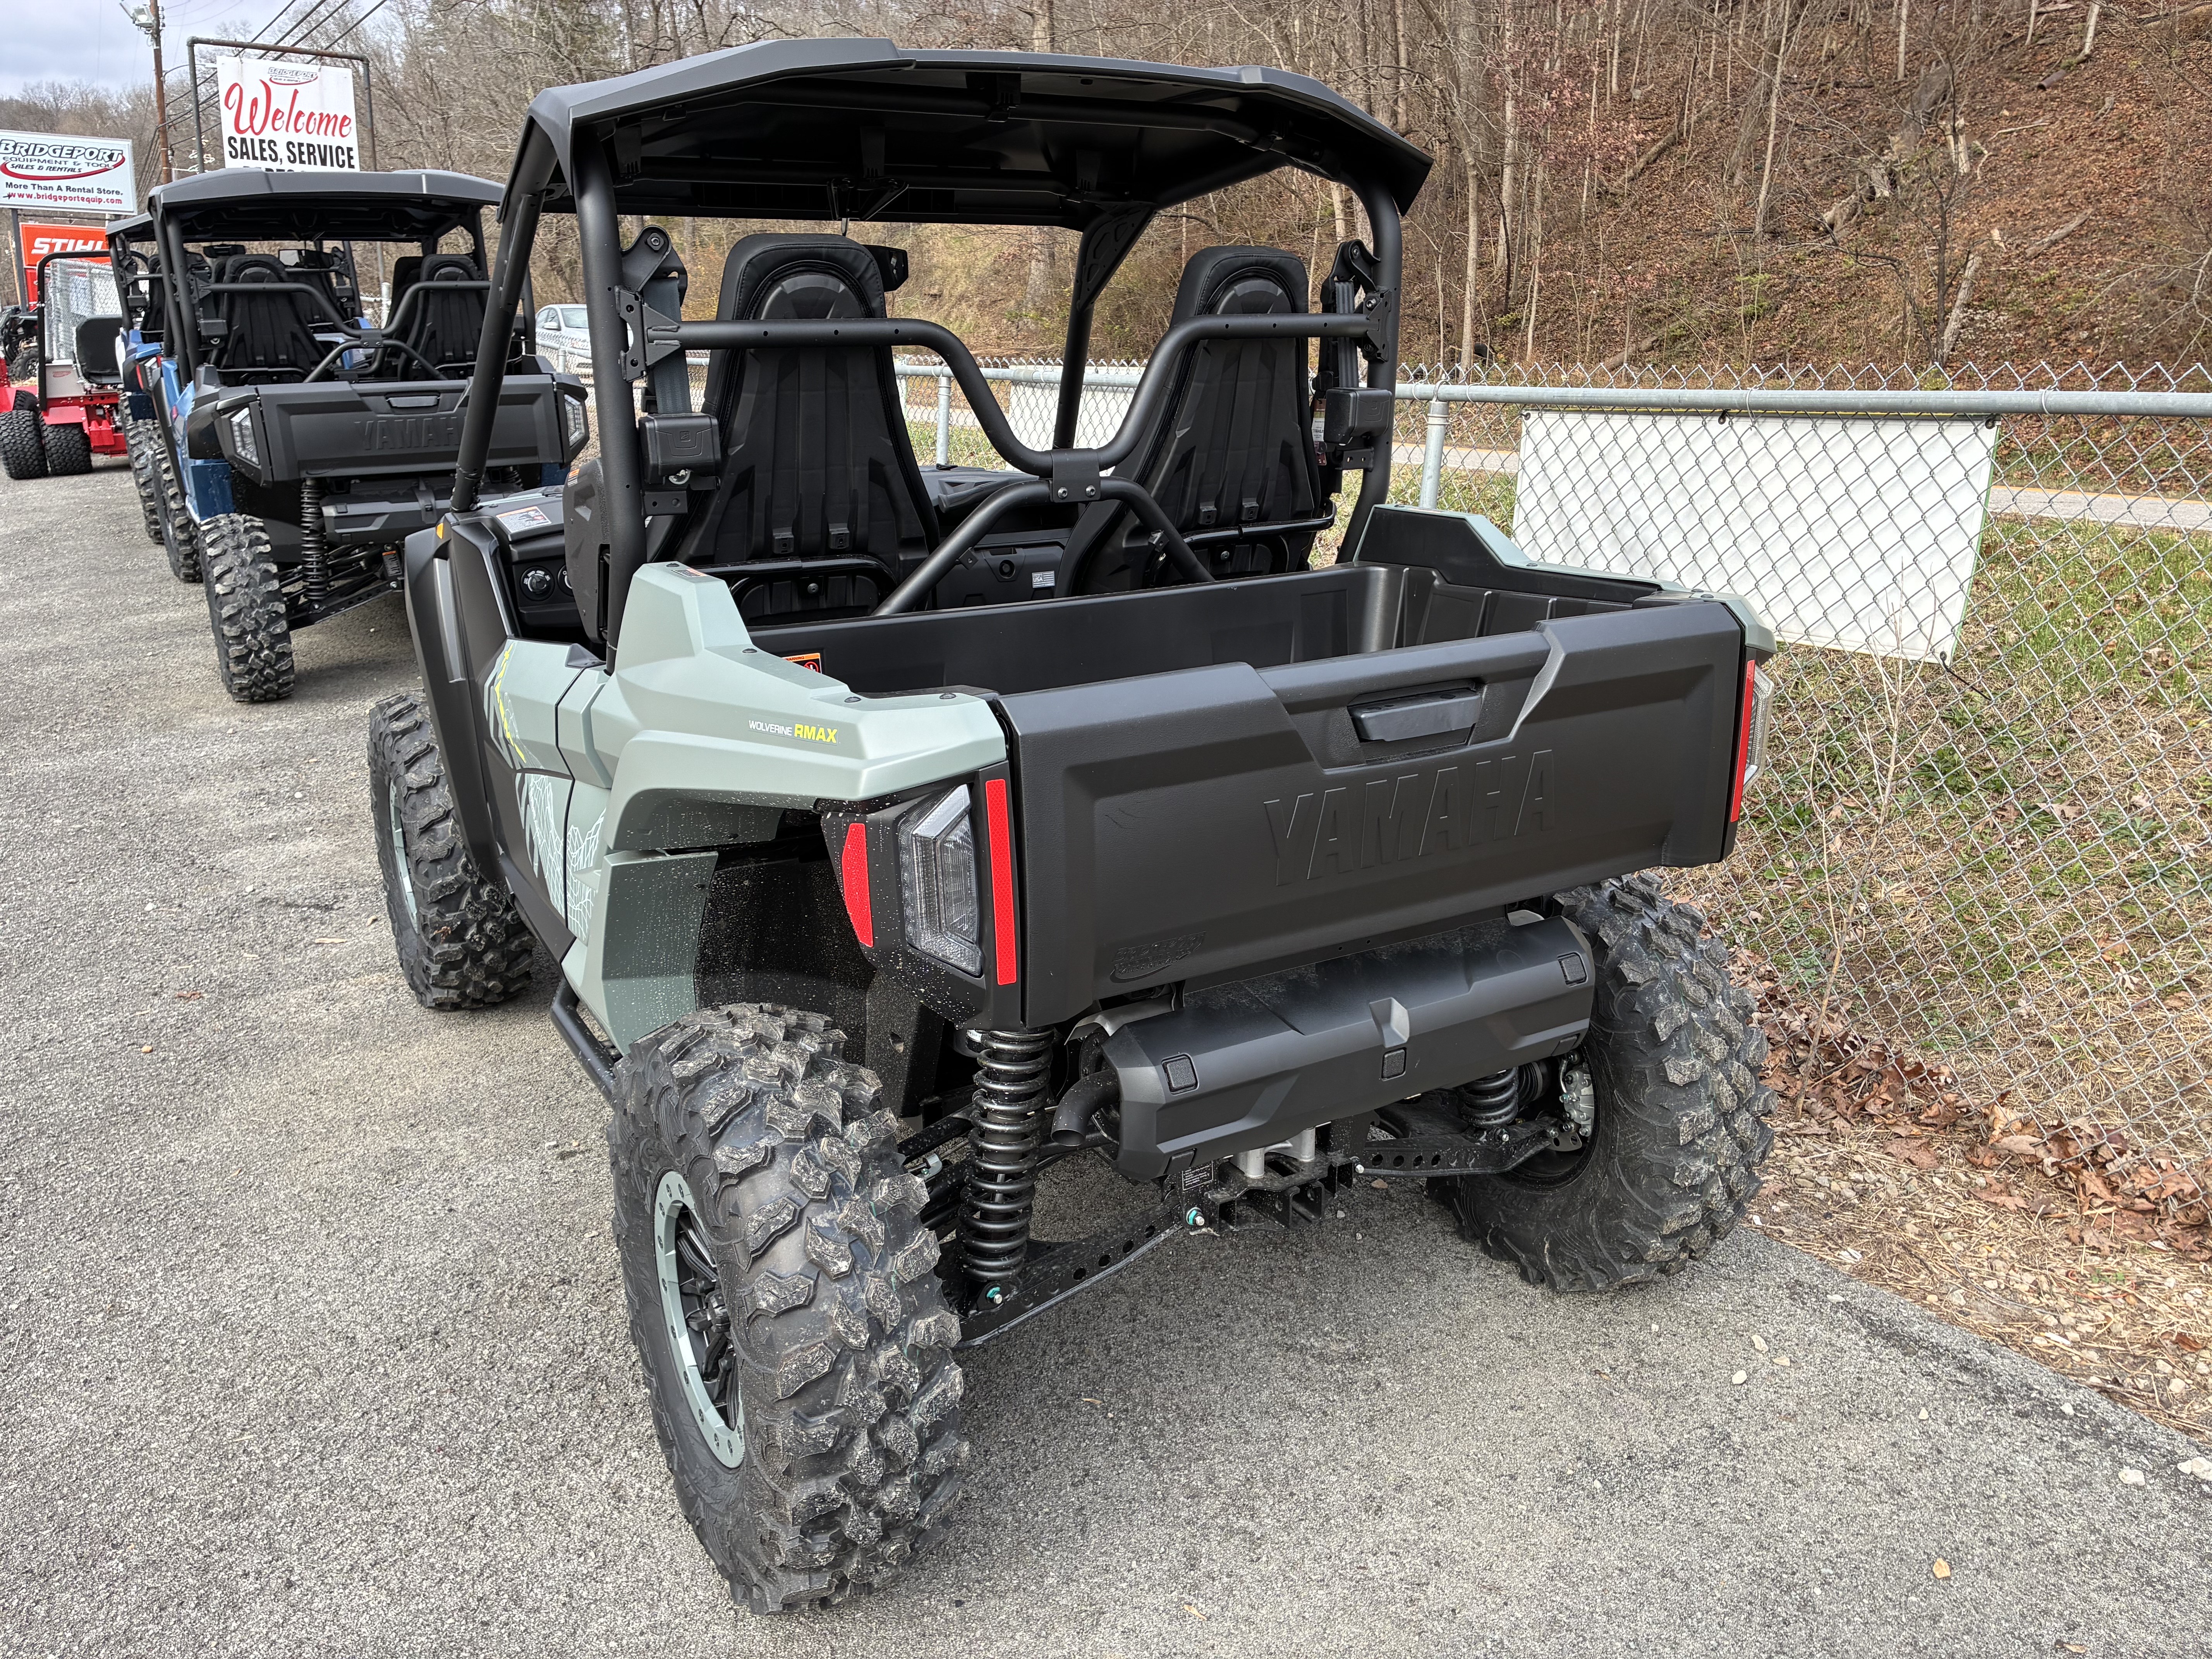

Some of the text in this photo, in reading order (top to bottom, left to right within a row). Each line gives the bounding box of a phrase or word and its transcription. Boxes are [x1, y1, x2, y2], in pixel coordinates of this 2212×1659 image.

[267, 67, 318, 78] BRIDGEPORT
[224, 79, 352, 138] Welcome
[0, 139, 123, 162] BRIDGEPORT
[3, 156, 69, 165] EQUIPMENT
[228, 136, 355, 169] SALES, SERVICE
[5, 182, 28, 190] More
[31, 183, 53, 191] Than
[66, 185, 94, 194] Rental
[96, 188, 124, 196] Store.
[8, 192, 123, 204] www.bridgeportequip.com
[354, 416, 466, 450] YAMAH
[749, 720, 838, 743] WOLVERINE RMAX
[1264, 749, 1556, 886] YAMAHA
